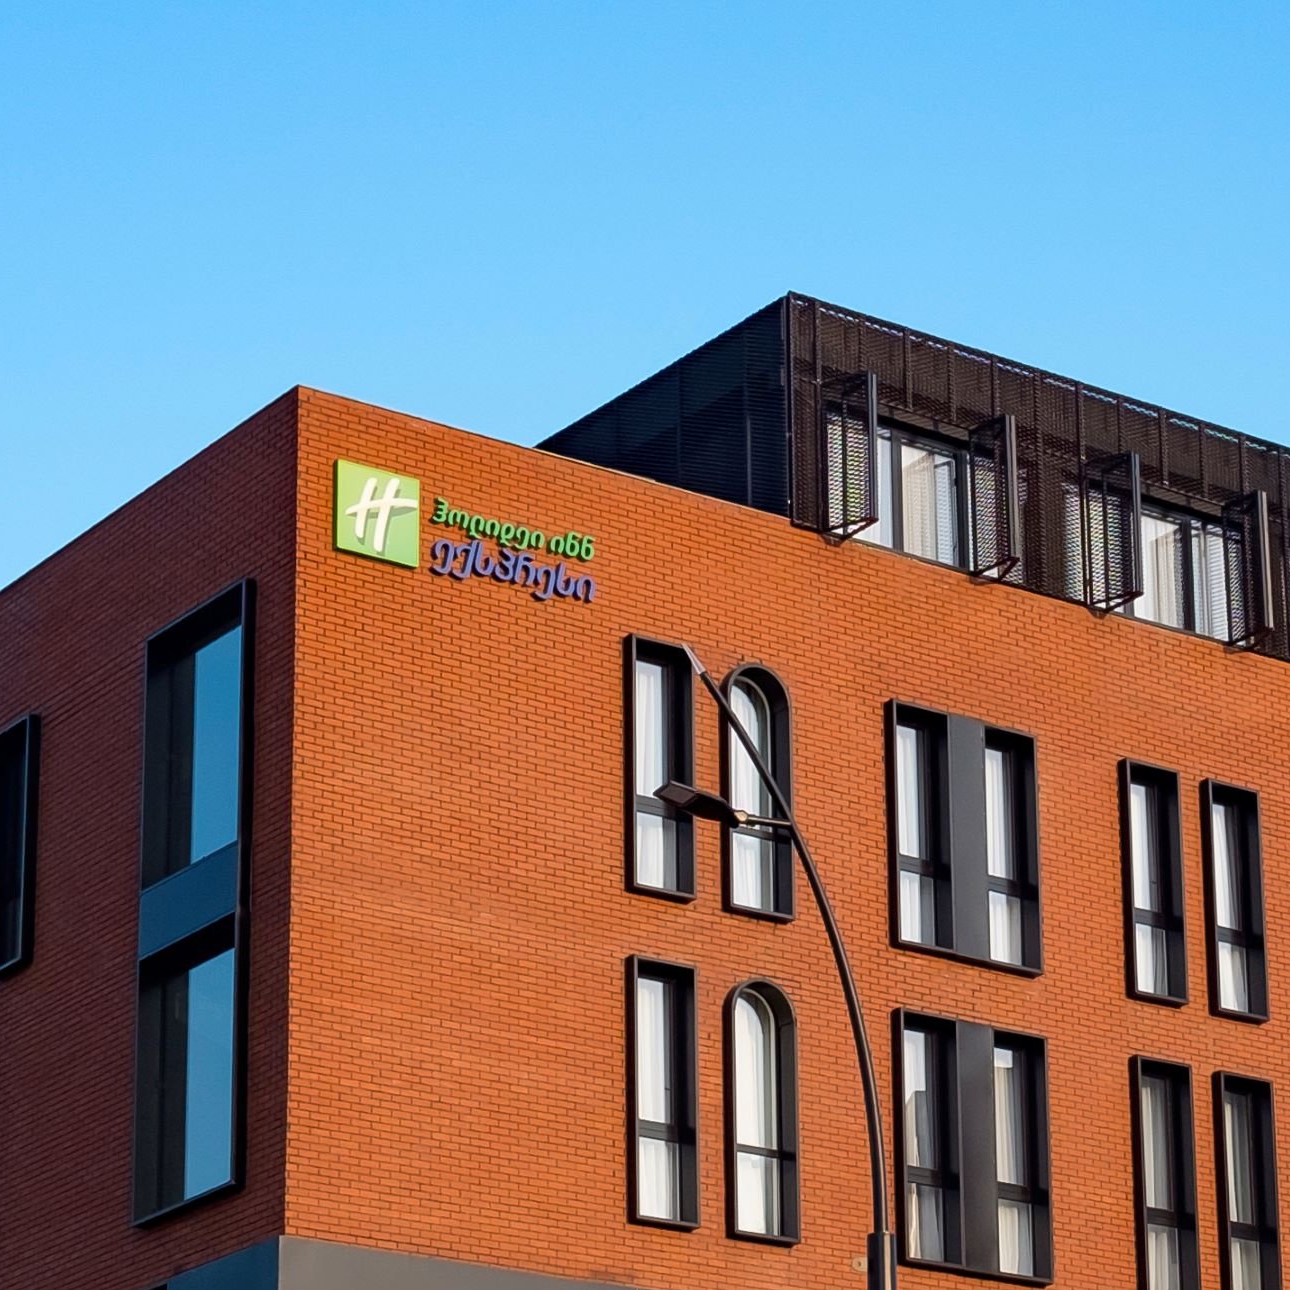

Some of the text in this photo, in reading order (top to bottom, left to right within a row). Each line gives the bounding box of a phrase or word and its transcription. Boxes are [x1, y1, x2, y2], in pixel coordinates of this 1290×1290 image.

[432, 497, 595, 561] ჰოლიდეი ინნ
[432, 539, 596, 602] ექსპრესი
